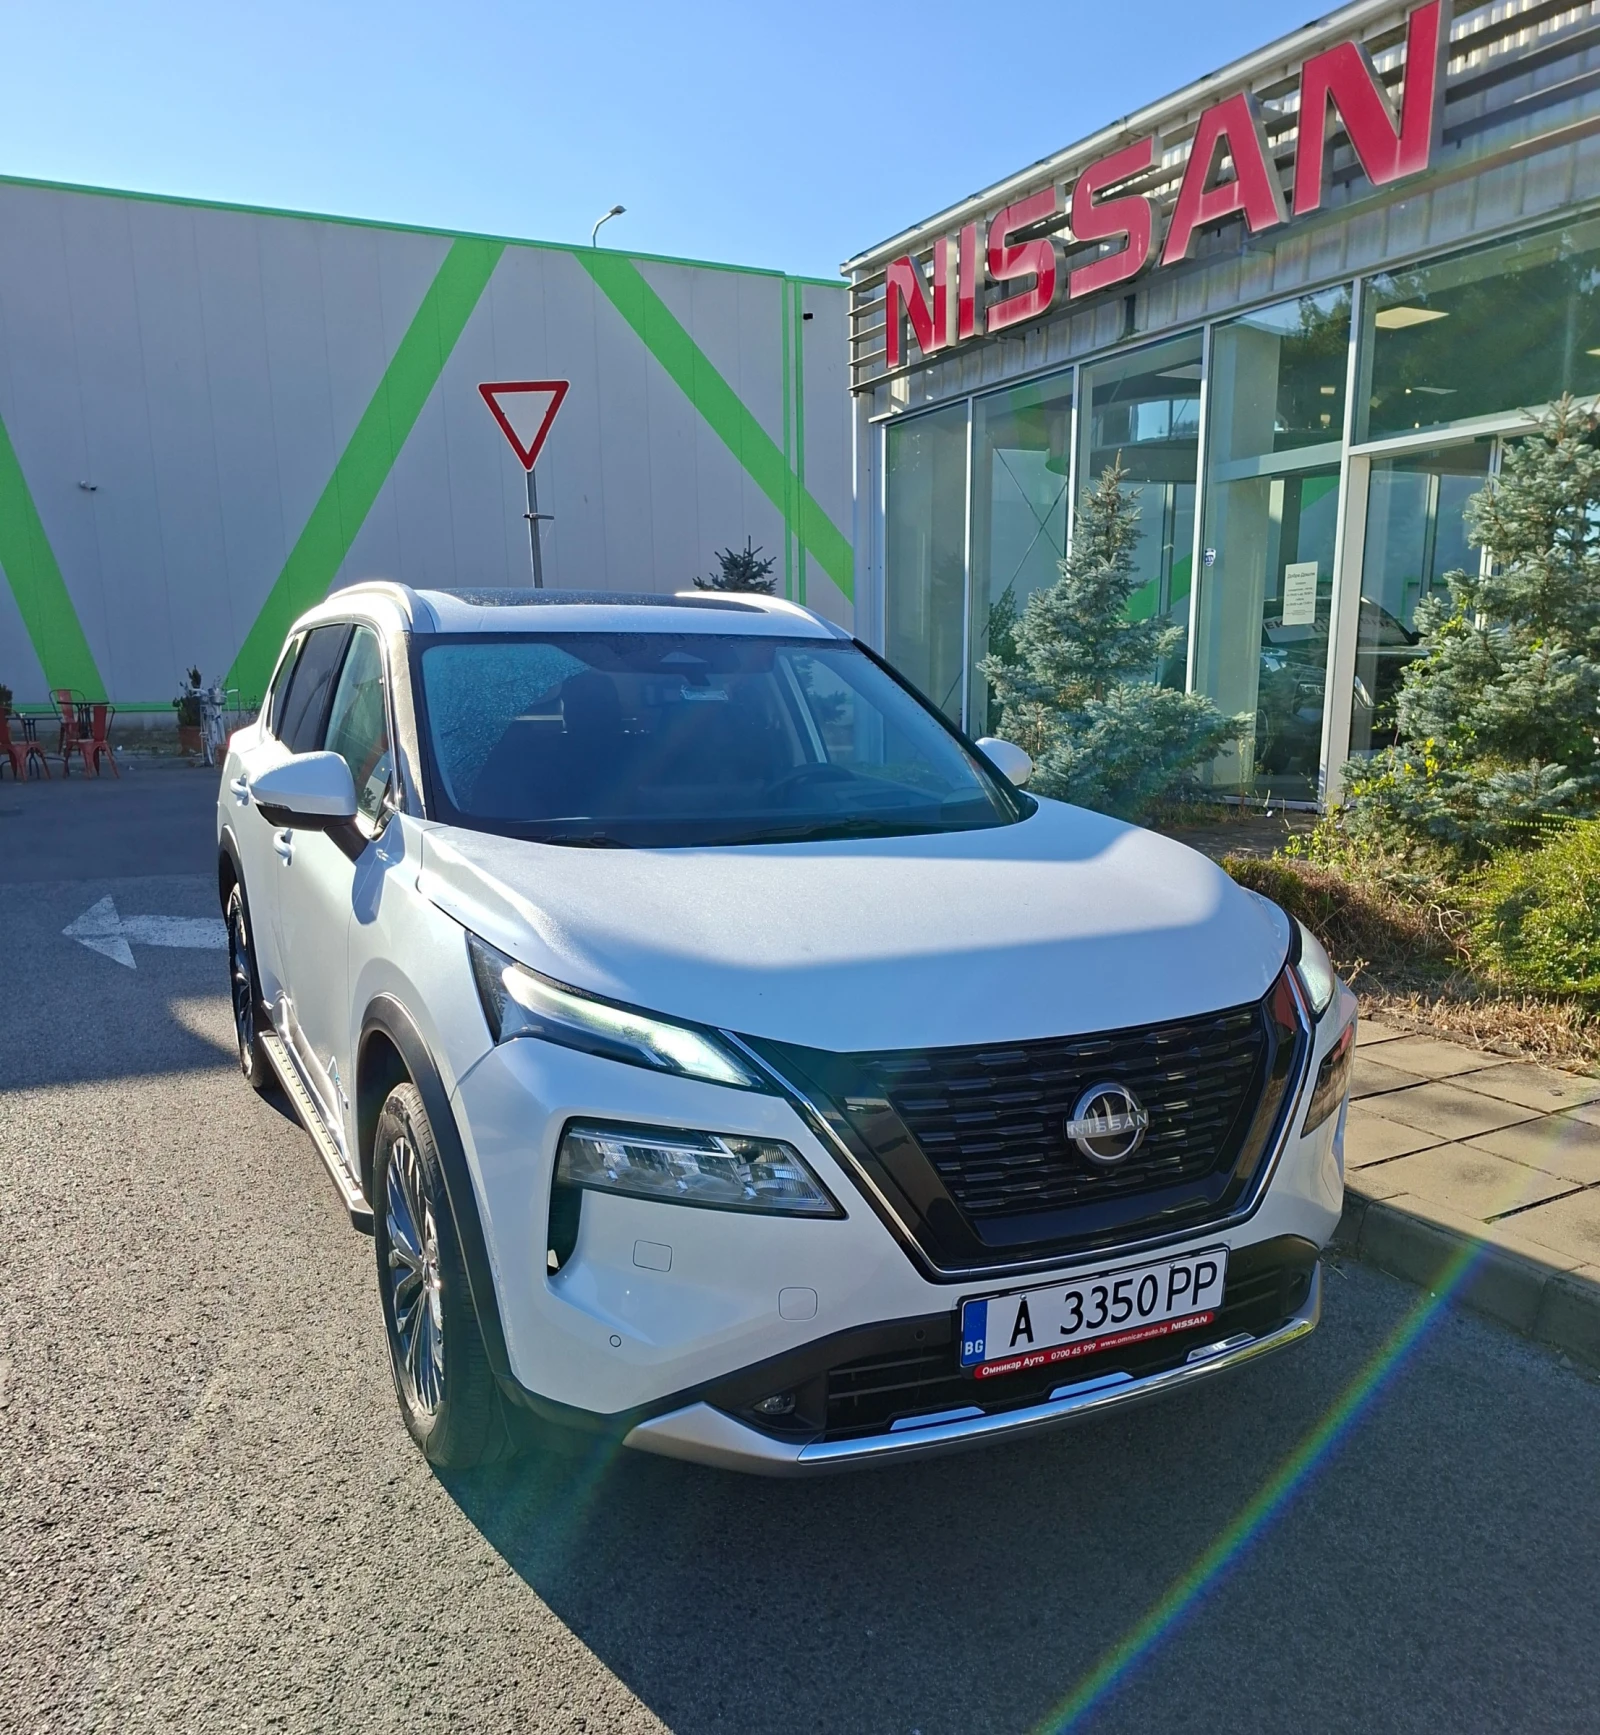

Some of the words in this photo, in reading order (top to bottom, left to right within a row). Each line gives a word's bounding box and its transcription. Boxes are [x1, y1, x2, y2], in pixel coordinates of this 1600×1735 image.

[885, 0, 1445, 370] NISSAN
[1069, 1112, 1147, 1136] NISSAN
[964, 1339, 984, 1356] BG
[1051, 1348, 1070, 1360] 0700
[1071, 1346, 1082, 1356] 45
[1083, 1342, 1097, 1353] 999
[1100, 1326, 1168, 1348] www.omnicar-auto.bg
[1171, 1315, 1208, 1331] NISSAN
[982, 1360, 1021, 1376] Омникар
[1023, 1355, 1044, 1367] Ауто
